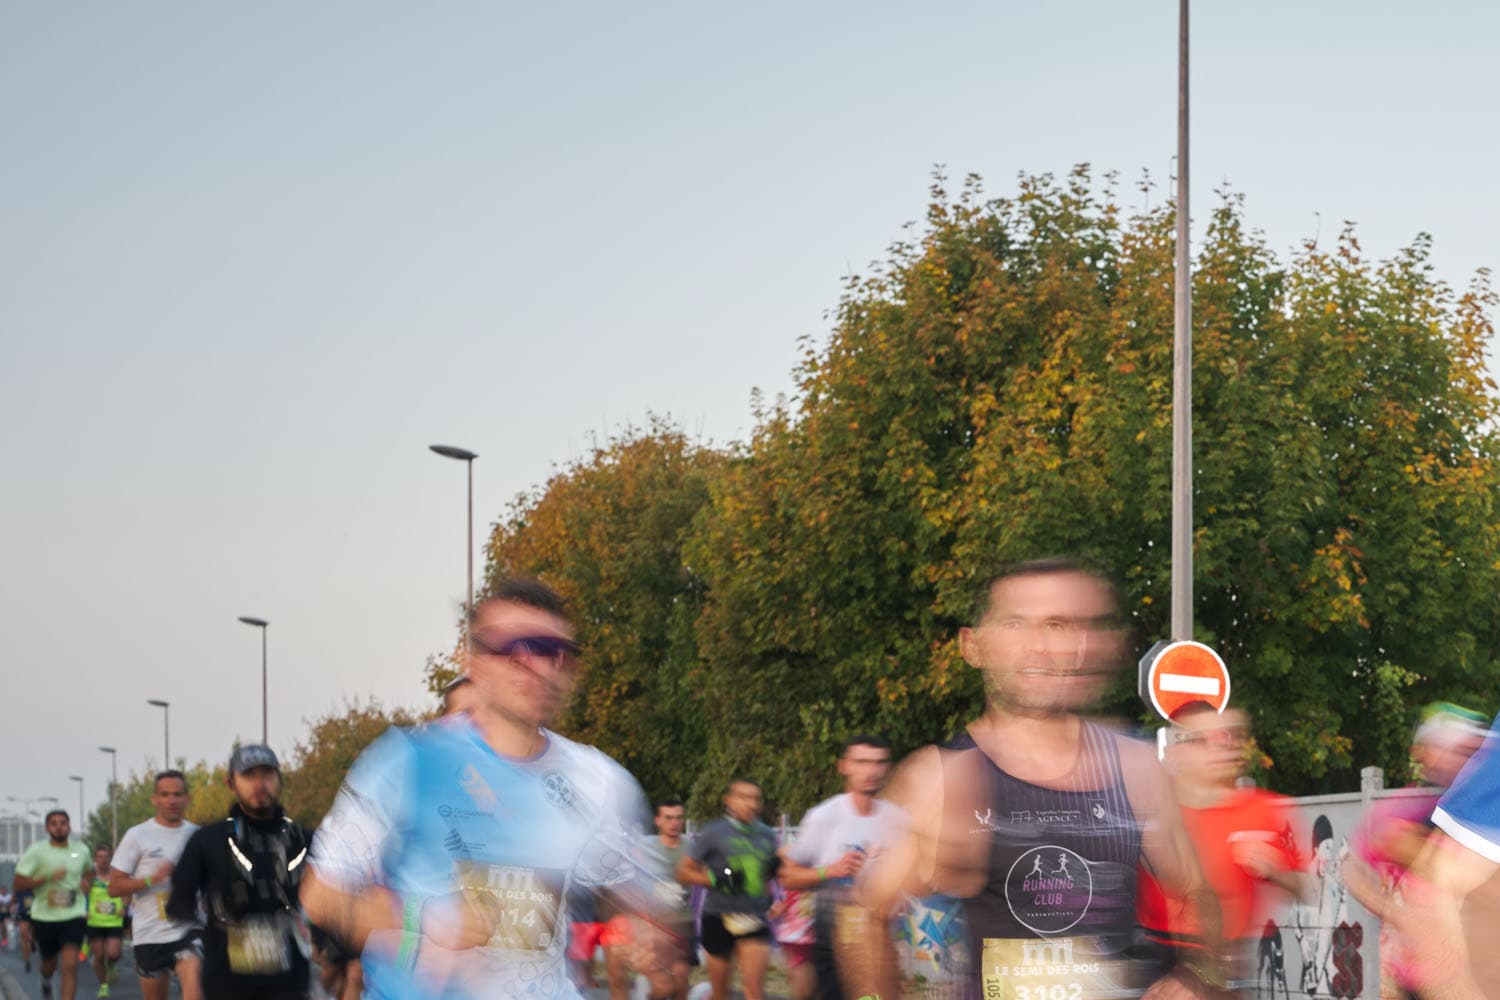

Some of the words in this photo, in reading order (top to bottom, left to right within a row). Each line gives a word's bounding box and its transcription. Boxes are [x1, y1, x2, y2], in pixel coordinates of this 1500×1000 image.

[1023, 878, 1074, 892] RUNNING
[506, 890, 527, 900] DES
[530, 892, 554, 903] ROIS
[1034, 892, 1063, 906] CLUB
[994, 966, 1009, 976] LE
[1013, 966, 1042, 976] SEMI
[1047, 964, 1069, 976] DES
[1072, 963, 1100, 974] ROIS
